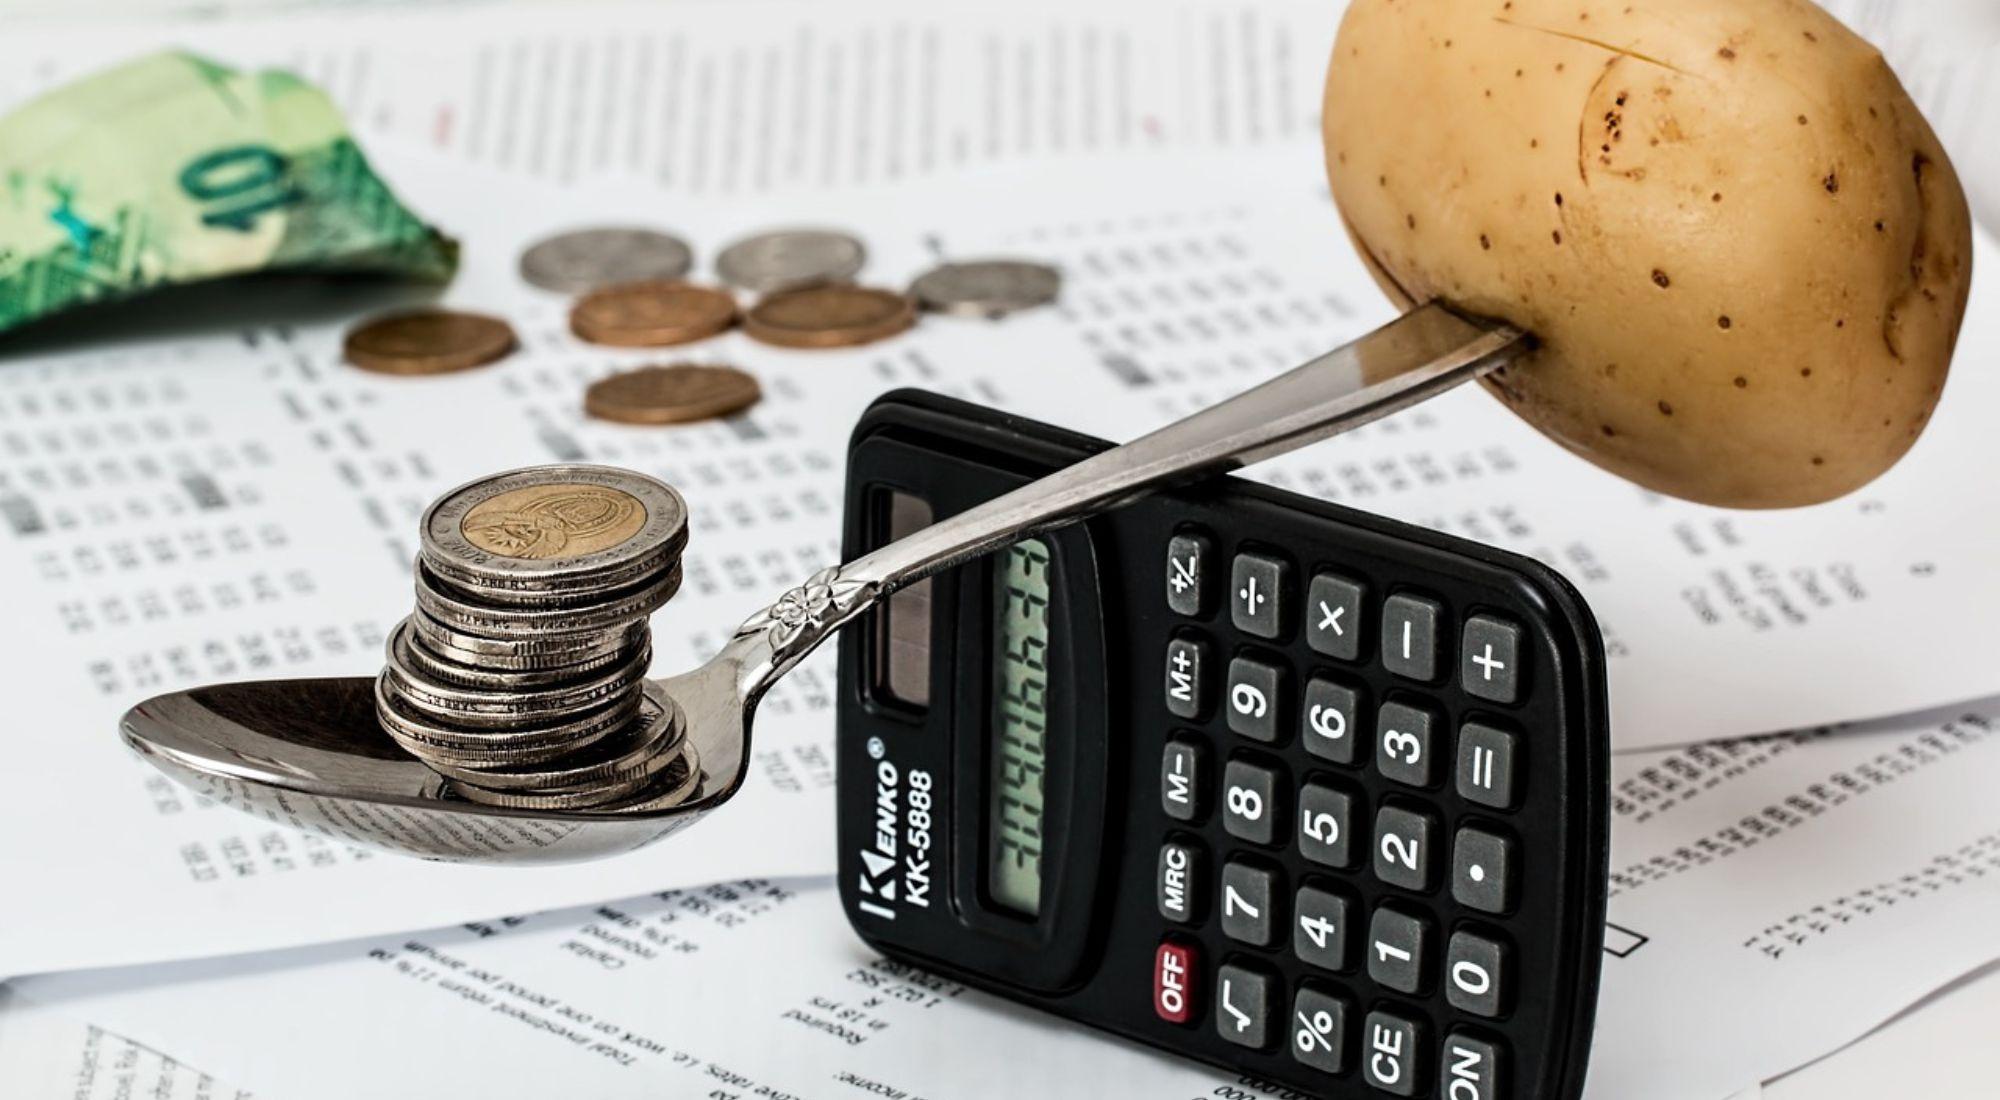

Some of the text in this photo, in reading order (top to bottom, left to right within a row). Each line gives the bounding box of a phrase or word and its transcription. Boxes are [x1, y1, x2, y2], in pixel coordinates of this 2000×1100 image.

[177, 143, 308, 233] 10
[1169, 649, 1192, 702] M+
[1231, 682, 1267, 719] 9
[1309, 703, 1347, 740] 6
[1383, 728, 1421, 765] 3
[1167, 753, 1190, 804] M-
[1227, 785, 1264, 822] 8
[858, 759, 899, 921] KENKO
[904, 768, 933, 908] KK-5888
[1303, 808, 1340, 846] 5
[1381, 832, 1419, 871] 2
[1163, 847, 1187, 912] MRC
[1225, 884, 1260, 919] 7
[1300, 914, 1336, 949] 4
[561, 940, 627, 971] Capital
[1374, 939, 1412, 963] 1
[438, 979, 493, 1006] return
[495, 981, 560, 1009] period
[1160, 950, 1185, 1014] OFF
[1452, 961, 1491, 996] 0
[491, 1002, 592, 1046] investment
[555, 1006, 594, 1024] one
[594, 1021, 621, 1037] on
[781, 1009, 868, 1046] Required
[1296, 1010, 1334, 1052] %
[587, 1041, 638, 1067] Total
[619, 1031, 667, 1055] work
[1371, 1023, 1403, 1085] CE
[1449, 1046, 1482, 1100] ON
